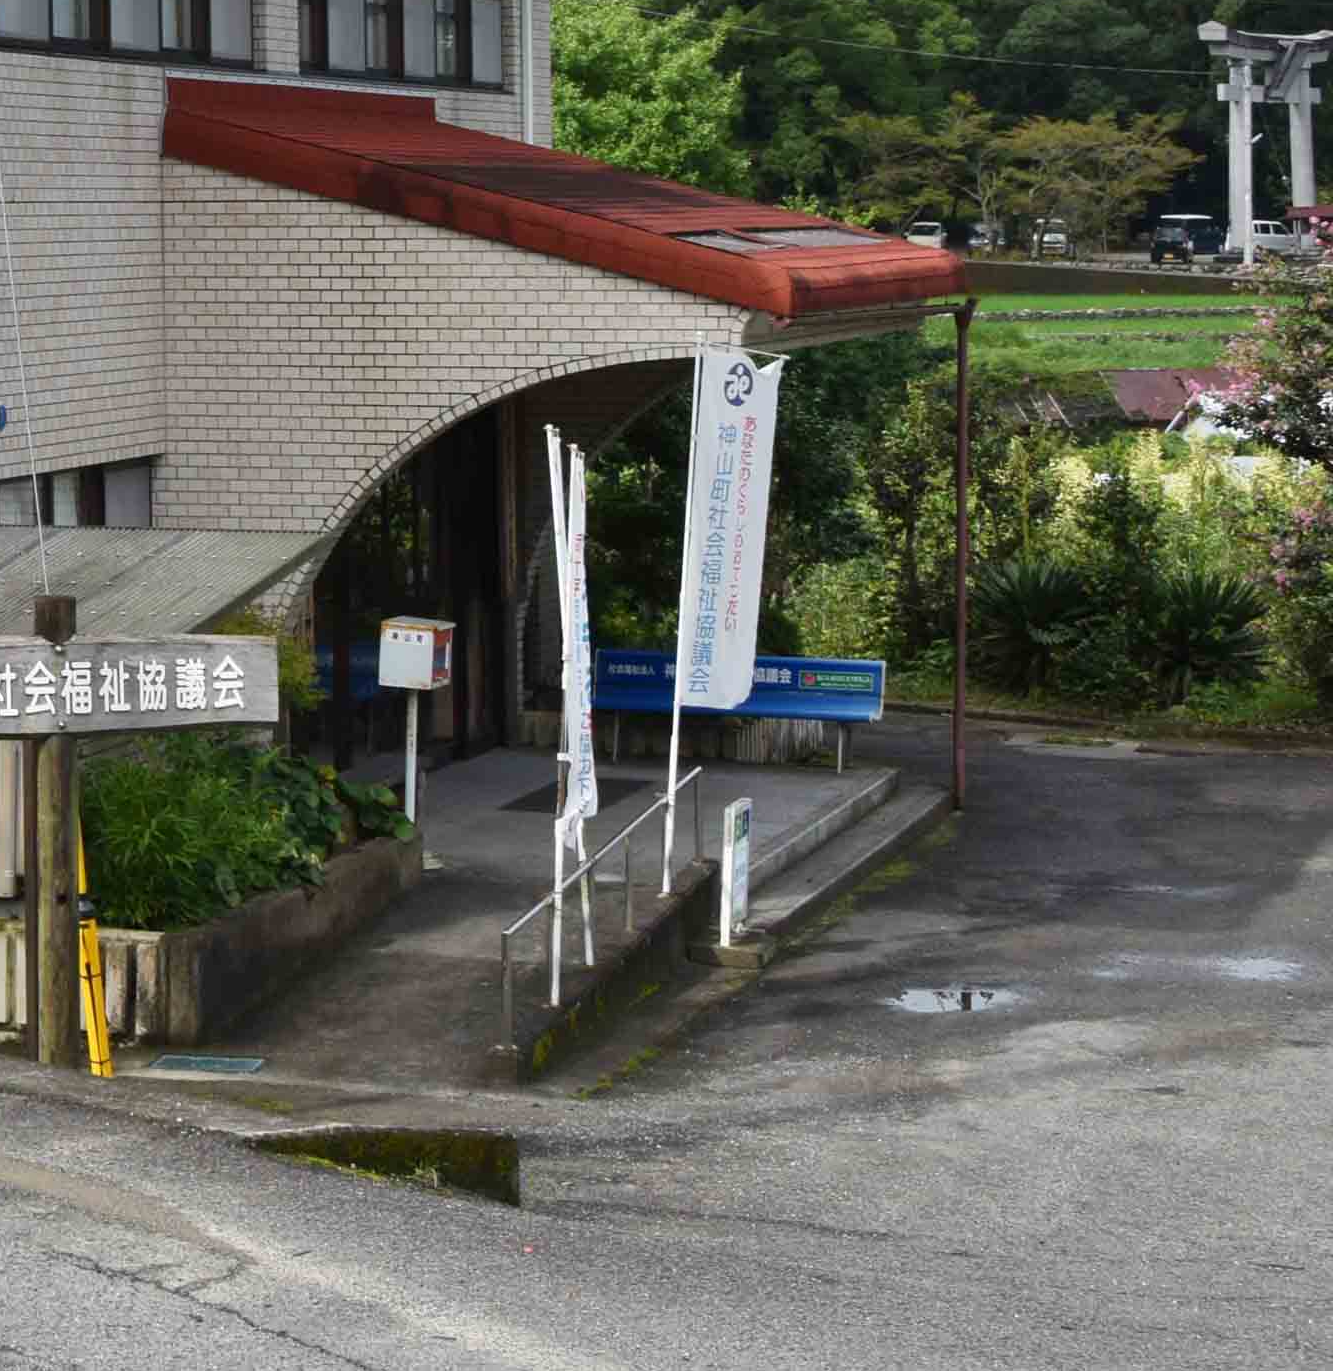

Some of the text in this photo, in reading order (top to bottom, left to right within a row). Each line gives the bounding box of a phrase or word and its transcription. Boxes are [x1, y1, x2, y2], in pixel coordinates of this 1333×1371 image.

[687, 422, 737, 694] 神山町社会福祉協議会
